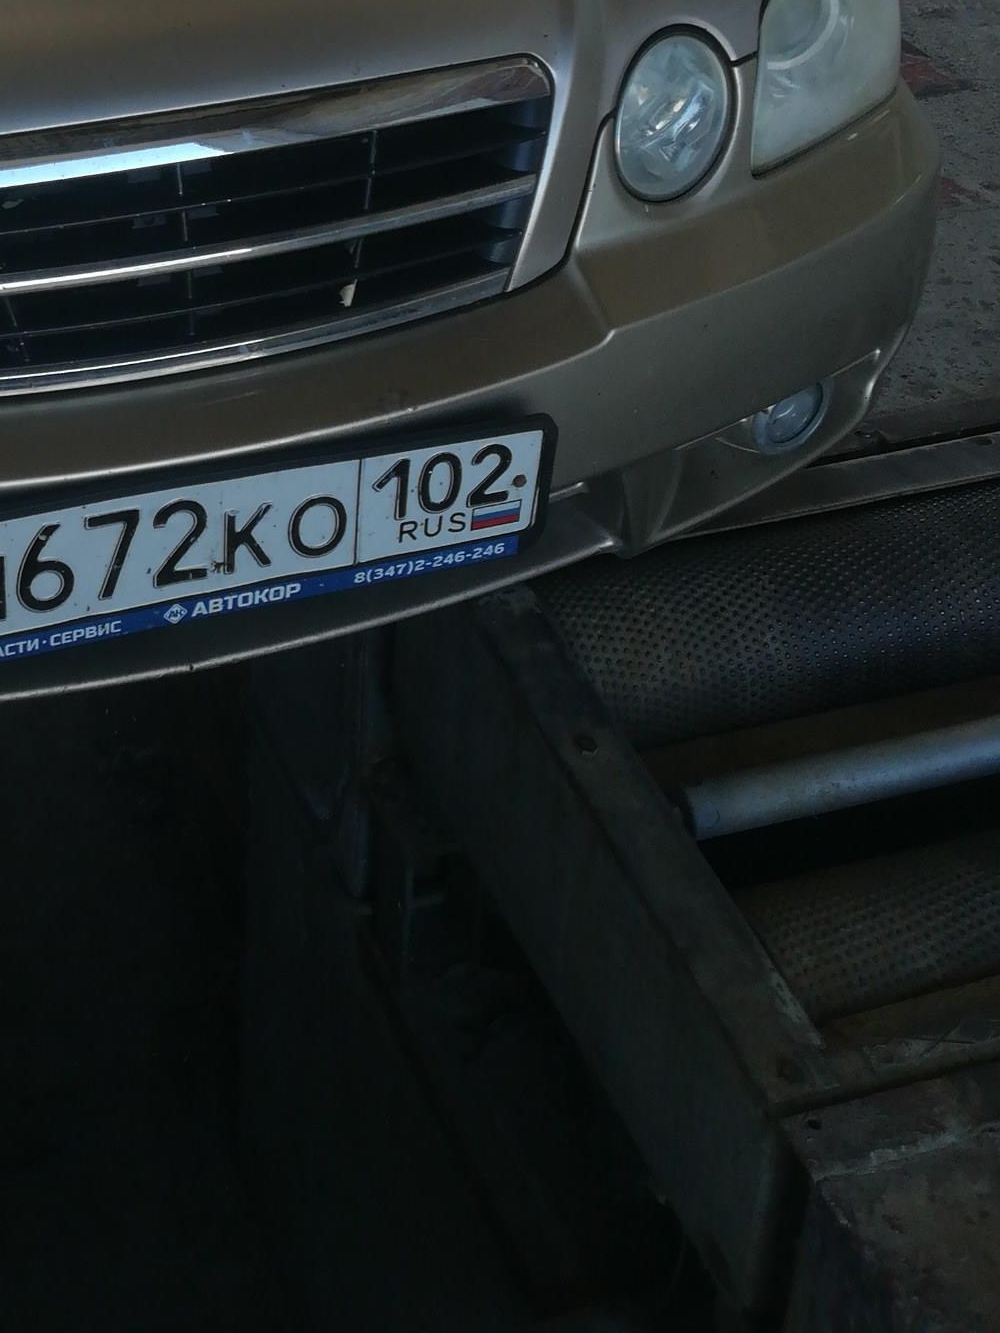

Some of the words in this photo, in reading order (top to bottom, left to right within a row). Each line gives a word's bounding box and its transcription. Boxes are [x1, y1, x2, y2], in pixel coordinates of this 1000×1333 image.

[372, 443, 513, 521] 102
[398, 512, 466, 544] RUS
[353, 542, 505, 584] 8(347)2-246-246
[191, 583, 302, 618] АВТОКОР
